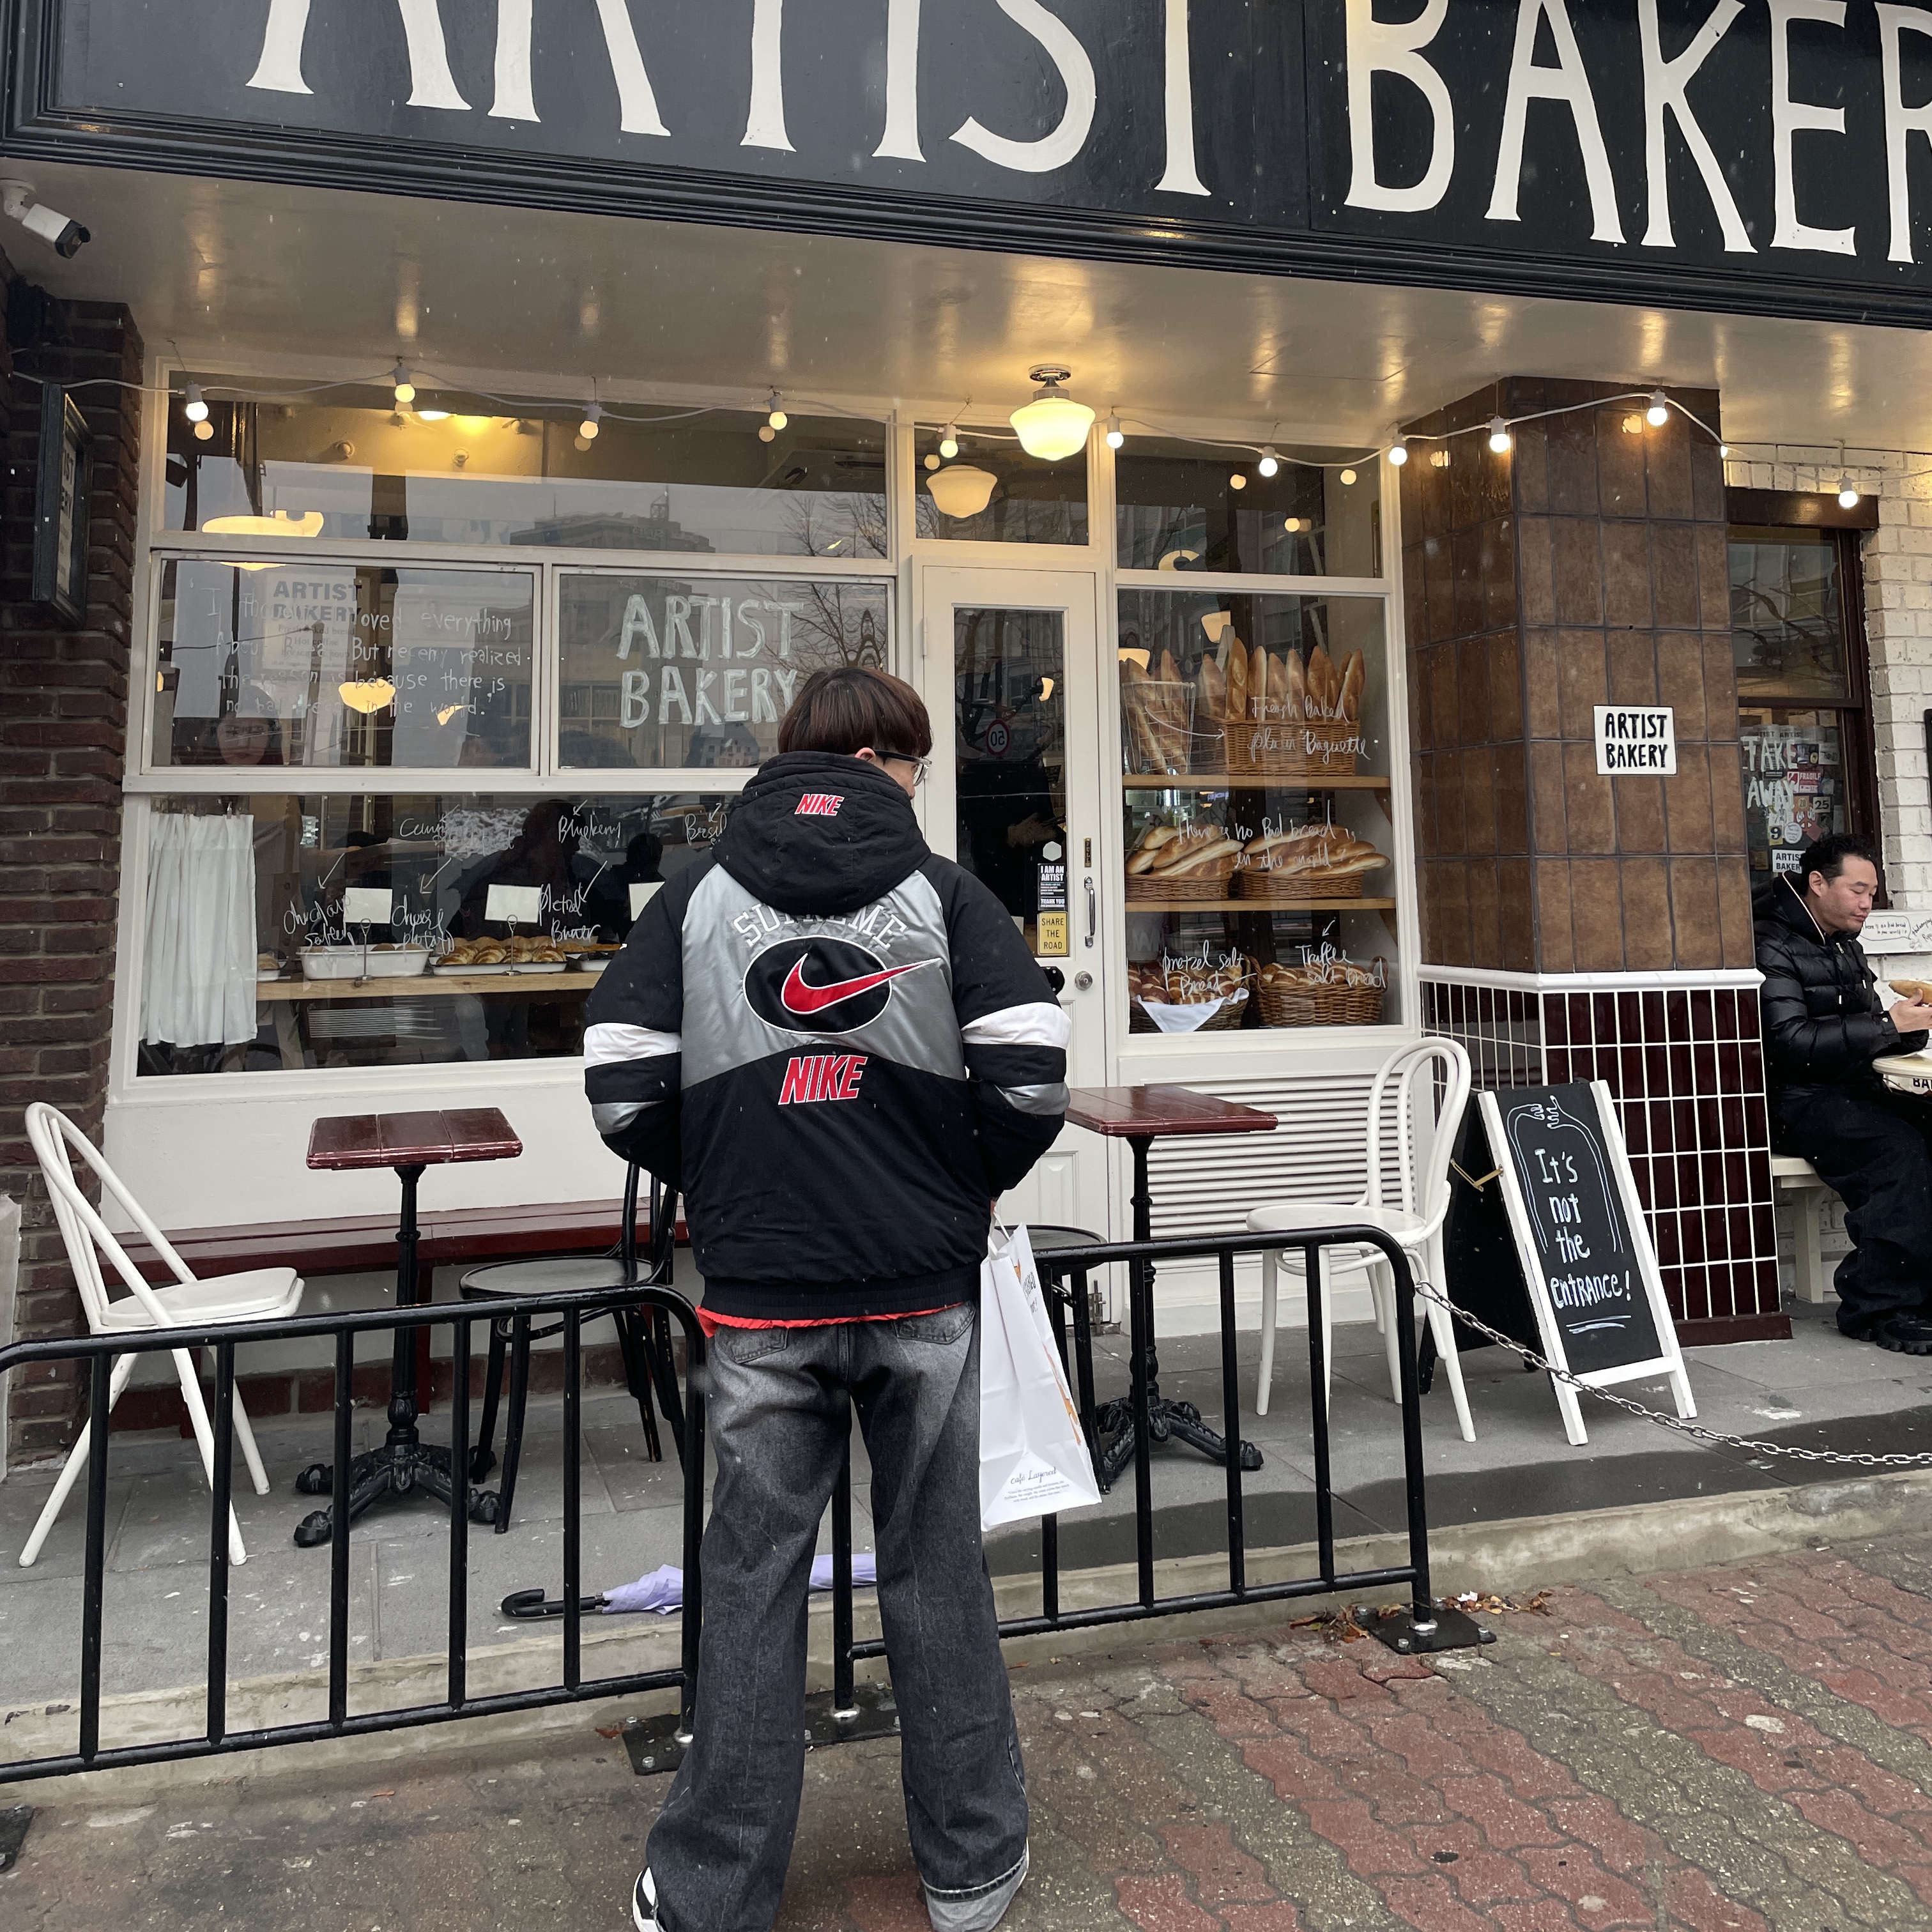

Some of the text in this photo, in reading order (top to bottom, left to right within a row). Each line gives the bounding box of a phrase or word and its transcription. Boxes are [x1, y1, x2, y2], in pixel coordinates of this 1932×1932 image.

[273, 581, 362, 601] ARTIST
[420, 608, 512, 640] everything
[617, 594, 804, 661] ARTIST
[352, 636, 380, 661] But
[460, 645, 521, 666] realized
[355, 670, 428, 690] because
[440, 668, 483, 691] there
[620, 664, 799, 728] BAKERY
[1605, 712, 1668, 739] ARTIST
[1606, 743, 1668, 769] BAKERY
[1740, 735, 1798, 772] TAKE
[795, 793, 845, 816] NIKE
[1747, 776, 1796, 809] AWAY
[1814, 800, 1829, 810] 25
[1770, 826, 1782, 840] 9
[1041, 865, 1064, 873] I AM AN
[1775, 852, 1801, 861] ARTIS
[1776, 862, 1801, 871] BAKER
[1041, 873, 1064, 882] ARTIST
[734, 903, 908, 949] SUME
[1041, 917, 1064, 926] SHARE
[1043, 941, 1062, 949] ROAD
[778, 1055, 869, 1106] NIKE
[1912, 1078, 1932, 1090] BA
[1534, 1147, 1578, 1184] It's
[1549, 1193, 1582, 1225] not
[1555, 1226, 1591, 1264] the
